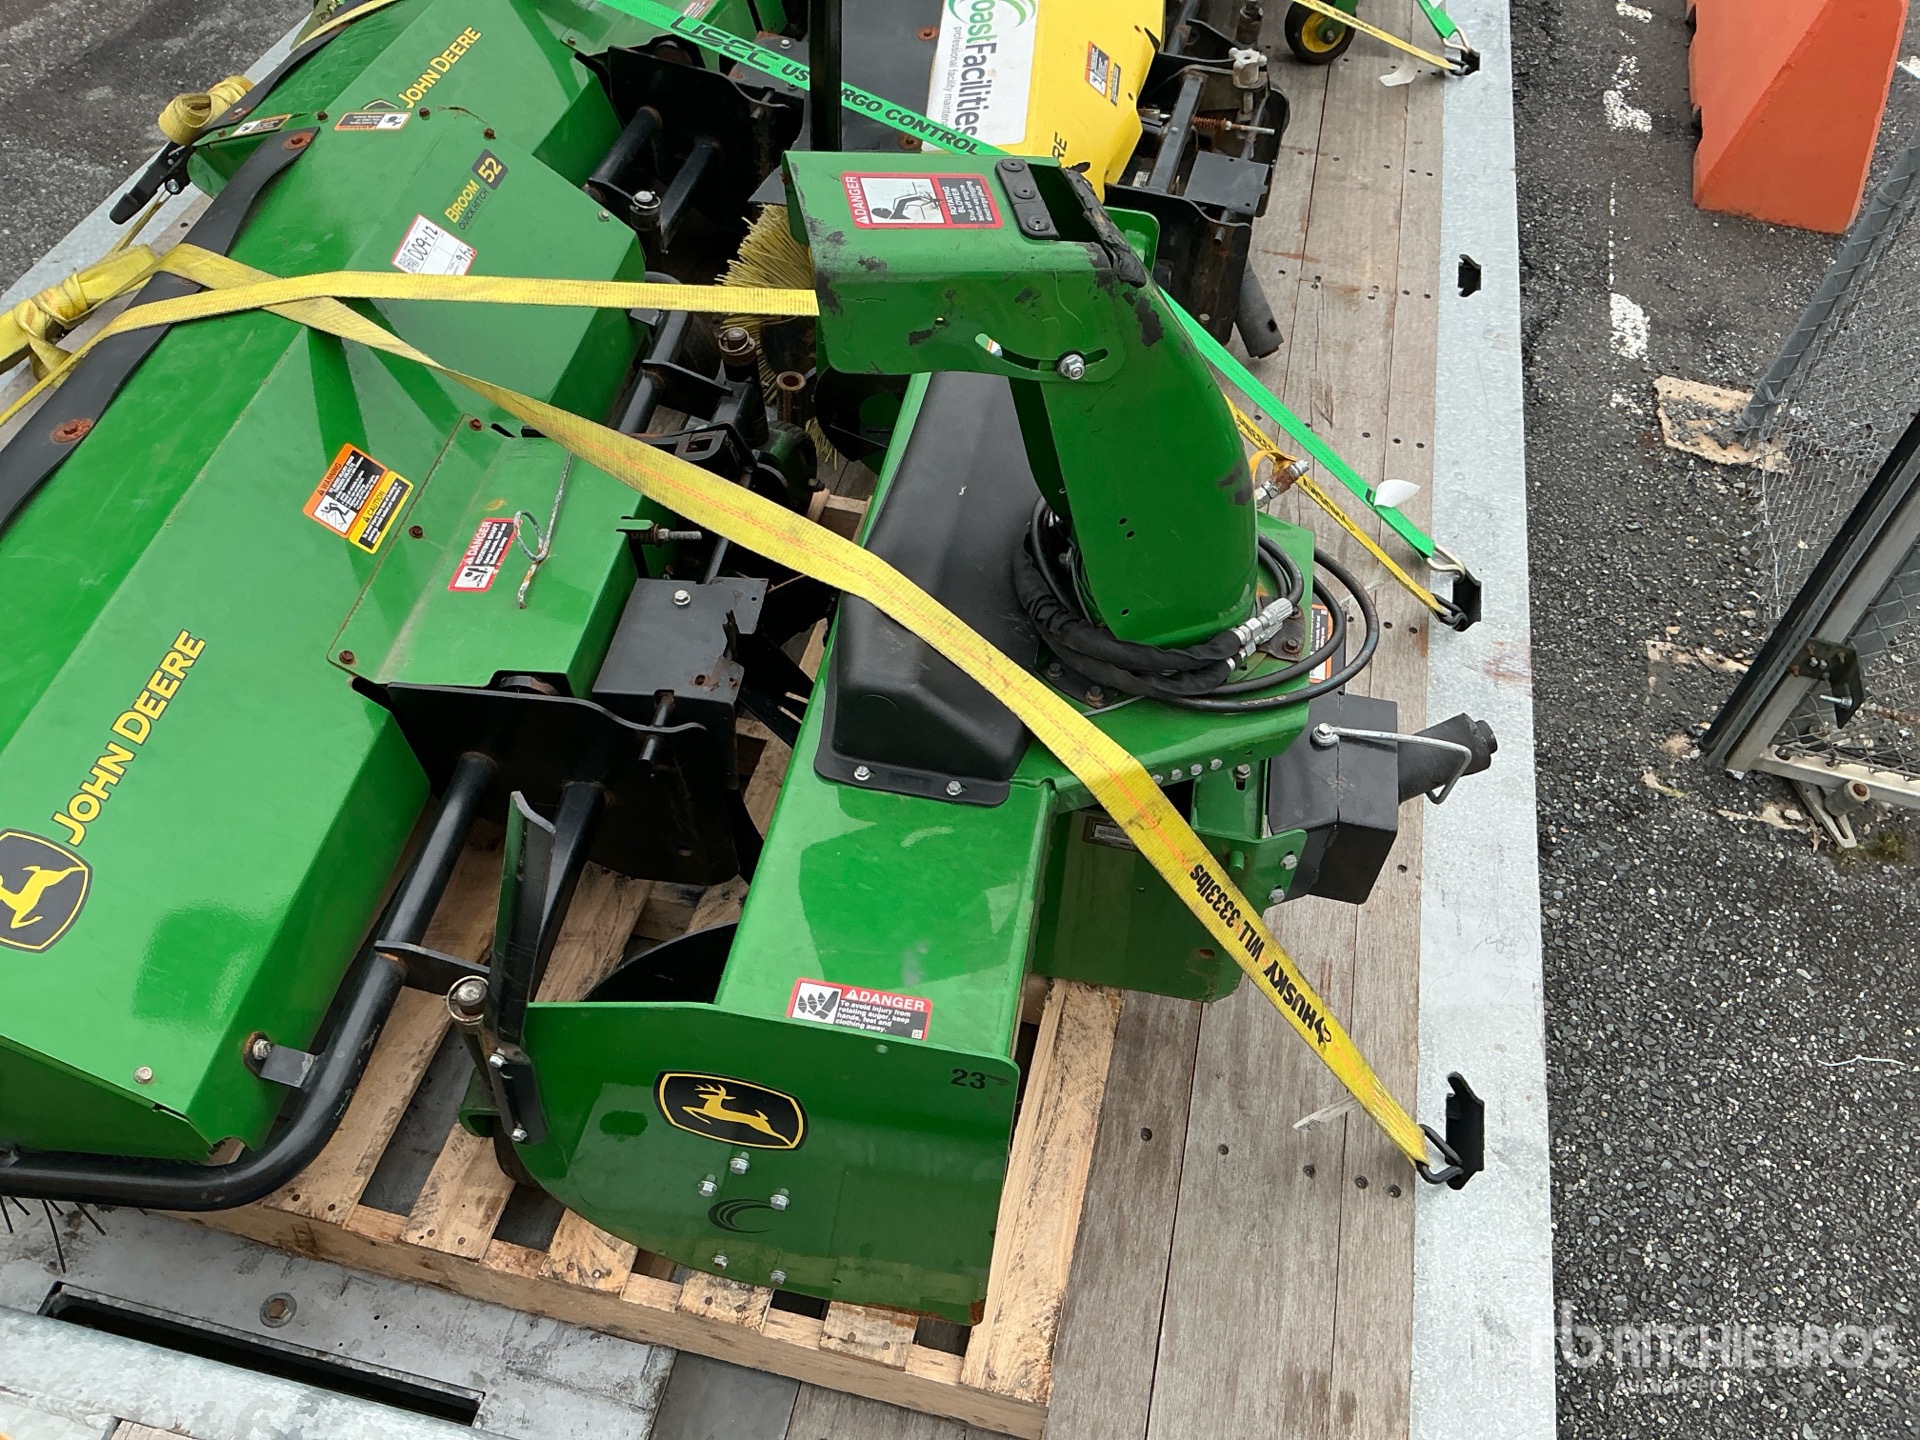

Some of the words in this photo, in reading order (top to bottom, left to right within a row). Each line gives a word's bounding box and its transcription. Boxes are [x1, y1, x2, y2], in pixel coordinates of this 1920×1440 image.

[397, 68, 441, 108] JOHN
[429, 26, 482, 73] DEERE
[943, 69, 958, 93] facility
[781, 63, 810, 81] US
[842, 88, 883, 112] RGO
[885, 108, 980, 155] CONTROL
[444, 179, 480, 223] BROOM
[478, 157, 502, 183] 52
[845, 176, 867, 216] DANGER
[942, 186, 959, 215] ROTATING
[951, 188, 966, 213] BLOWER
[458, 207, 476, 230] QUICK
[472, 187, 490, 211] HITCH
[323, 462, 342, 489] WARNING
[367, 490, 386, 516] CAUTION
[467, 521, 493, 556] DANGER
[52, 740, 137, 847] JOHN
[110, 629, 206, 746] DEERE
[1189, 864, 1241, 928] 3333lbs
[1238, 920, 1265, 963] WLL
[851, 1002, 871, 1010] avoid
[872, 1005, 893, 1015] injury
[859, 991, 925, 1011] DANGER
[1262, 960, 1317, 1030] HUSKY
[835, 1018, 865, 1030] clothing
[838, 1007, 866, 1017] rotating
[868, 1011, 890, 1021] auger,
[892, 1015, 910, 1024] keep
[877, 1019, 892, 1027] and
